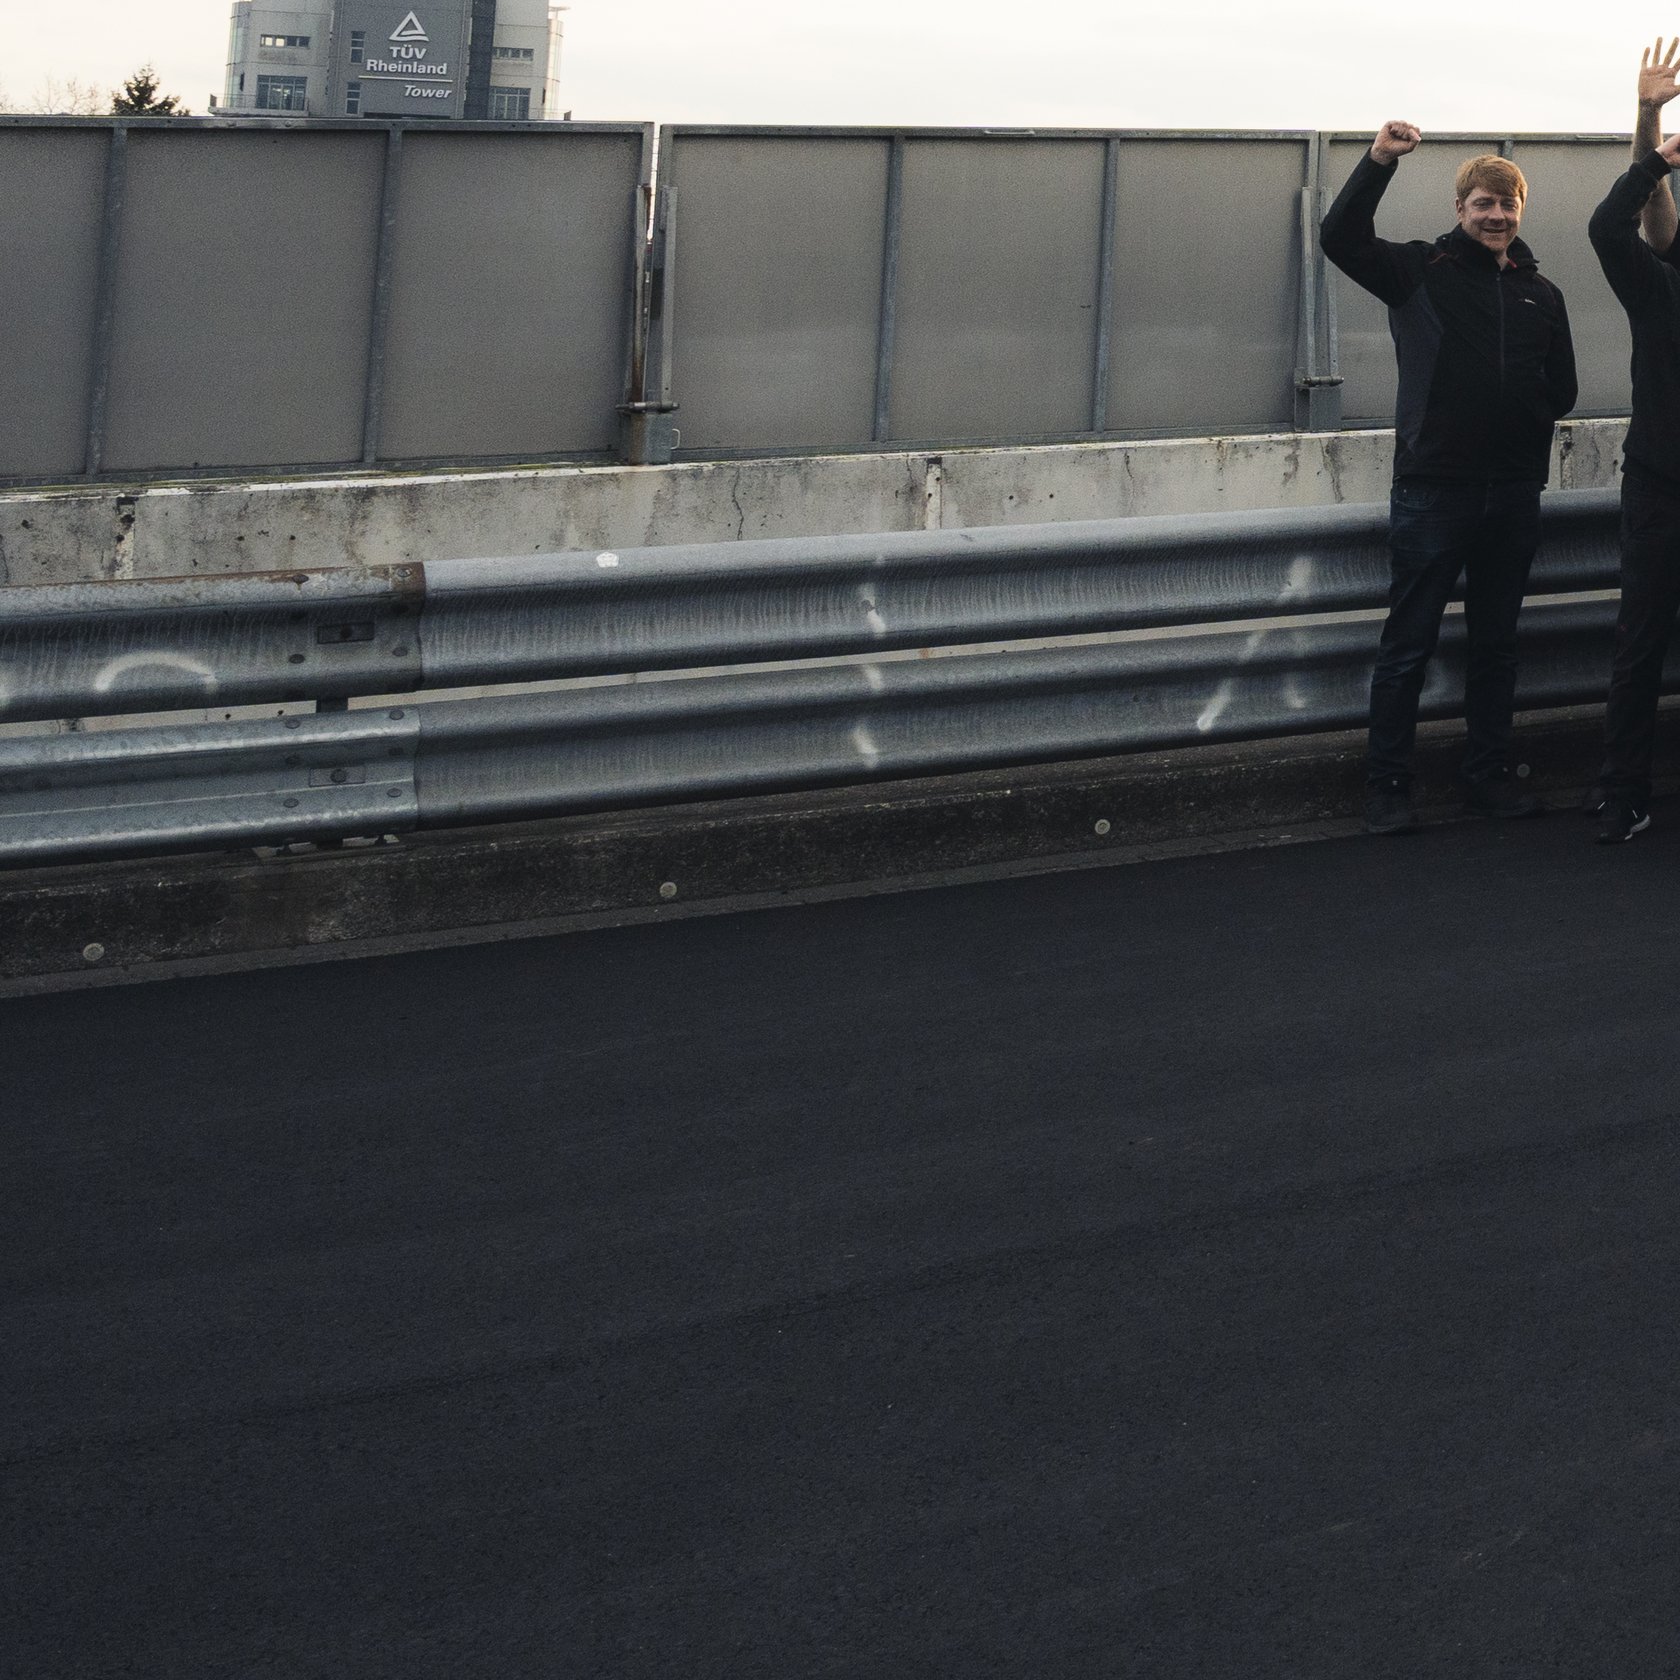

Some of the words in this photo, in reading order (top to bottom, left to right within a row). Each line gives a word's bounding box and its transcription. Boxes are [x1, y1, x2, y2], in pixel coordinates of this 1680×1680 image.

[389, 44, 427, 60] TÜV
[366, 59, 448, 75] Rheinland
[404, 85, 453, 99] Tower
